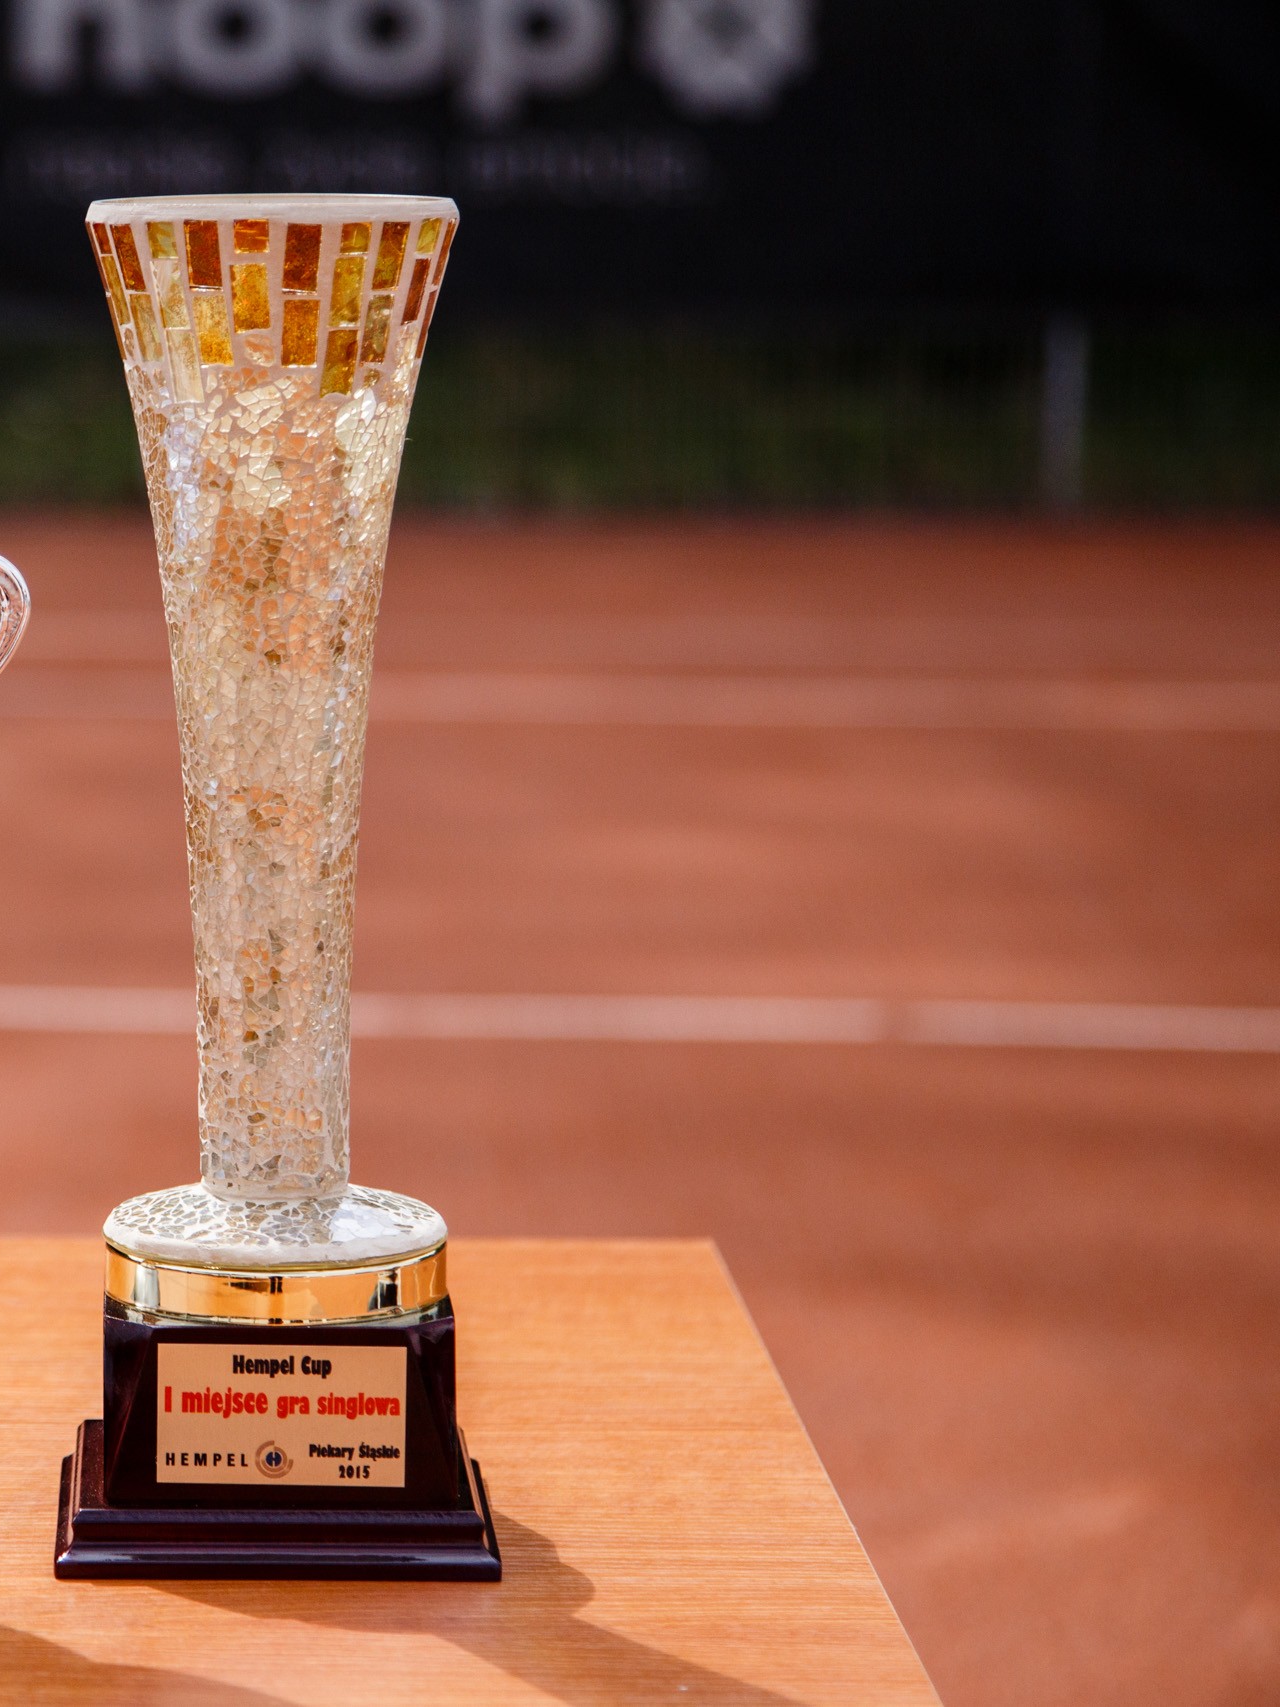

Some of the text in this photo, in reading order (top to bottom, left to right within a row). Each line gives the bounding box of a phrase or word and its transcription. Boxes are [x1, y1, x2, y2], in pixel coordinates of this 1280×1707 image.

[232, 1354, 333, 1379] Hempel Cup
[164, 1385, 401, 1420] I miejsce gra singlowa
[165, 1452, 249, 1468] HEMPEL
[308, 1441, 401, 1462] Piekary Śląskie
[338, 1465, 371, 1479] 2015
